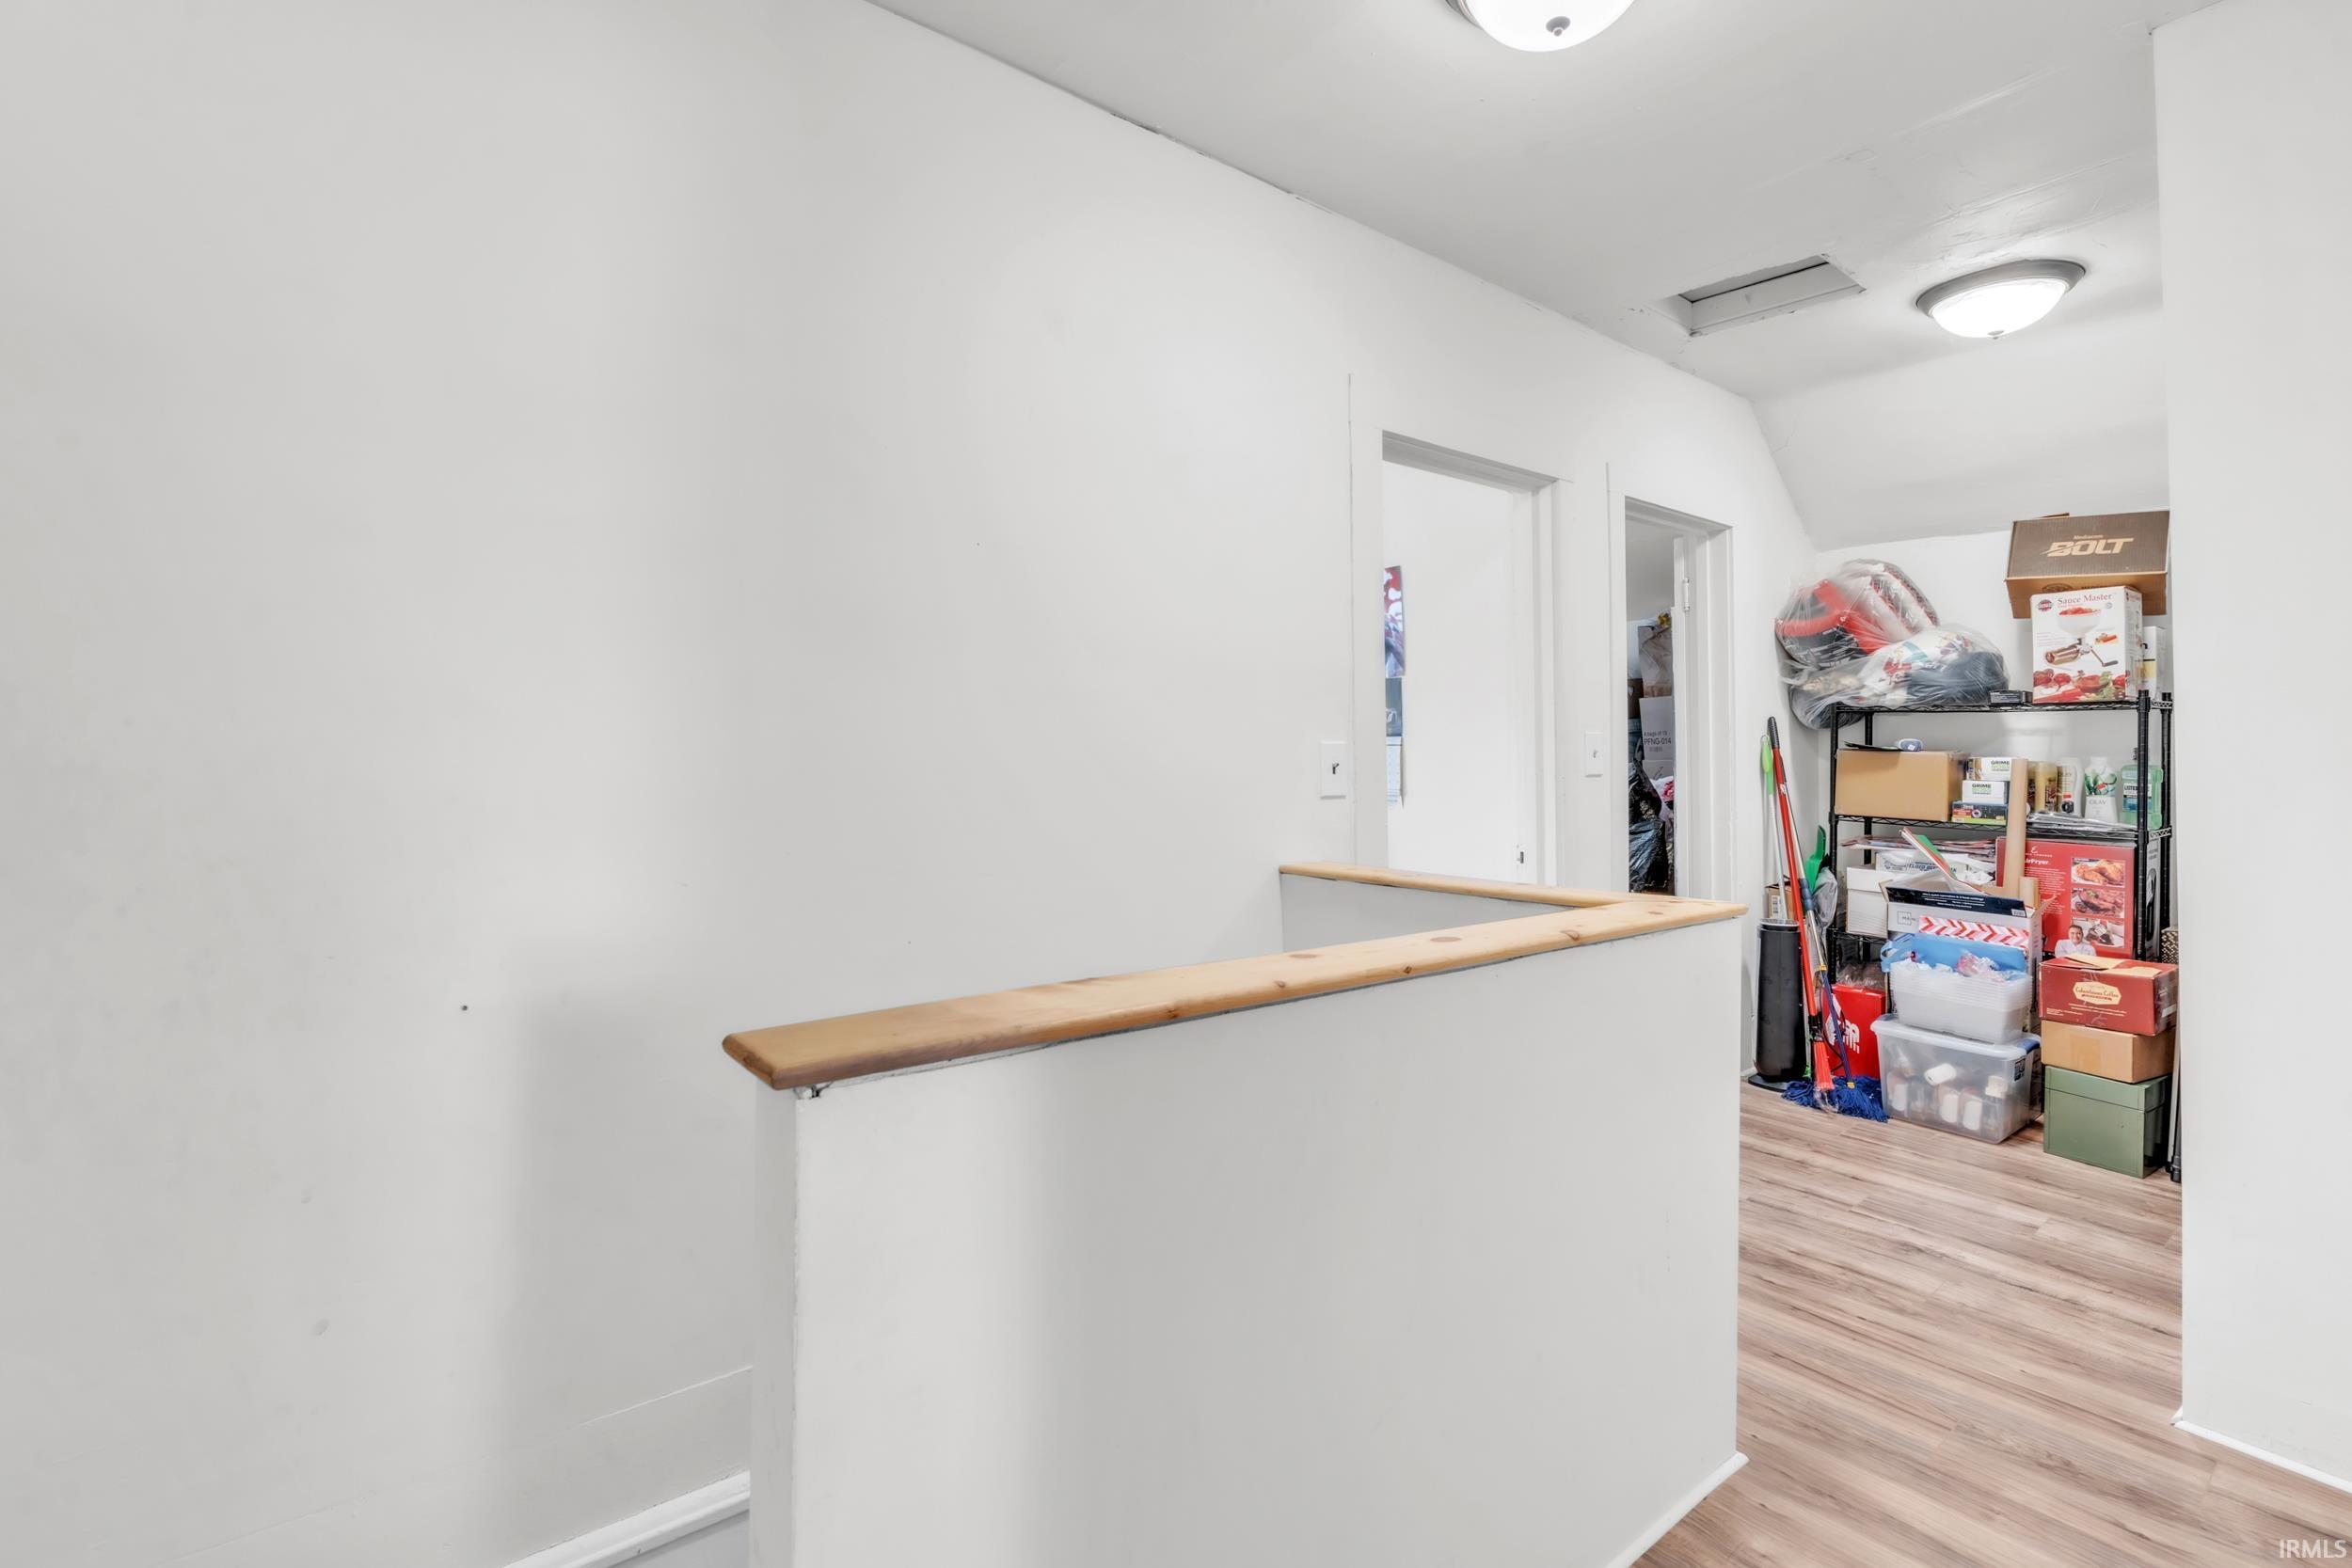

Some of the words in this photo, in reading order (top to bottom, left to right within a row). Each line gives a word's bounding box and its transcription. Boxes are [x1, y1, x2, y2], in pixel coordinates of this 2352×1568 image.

[2041, 538, 2135, 557] BOLT
[2058, 596, 2082, 605] Sauce
[2083, 594, 2113, 603] Master
